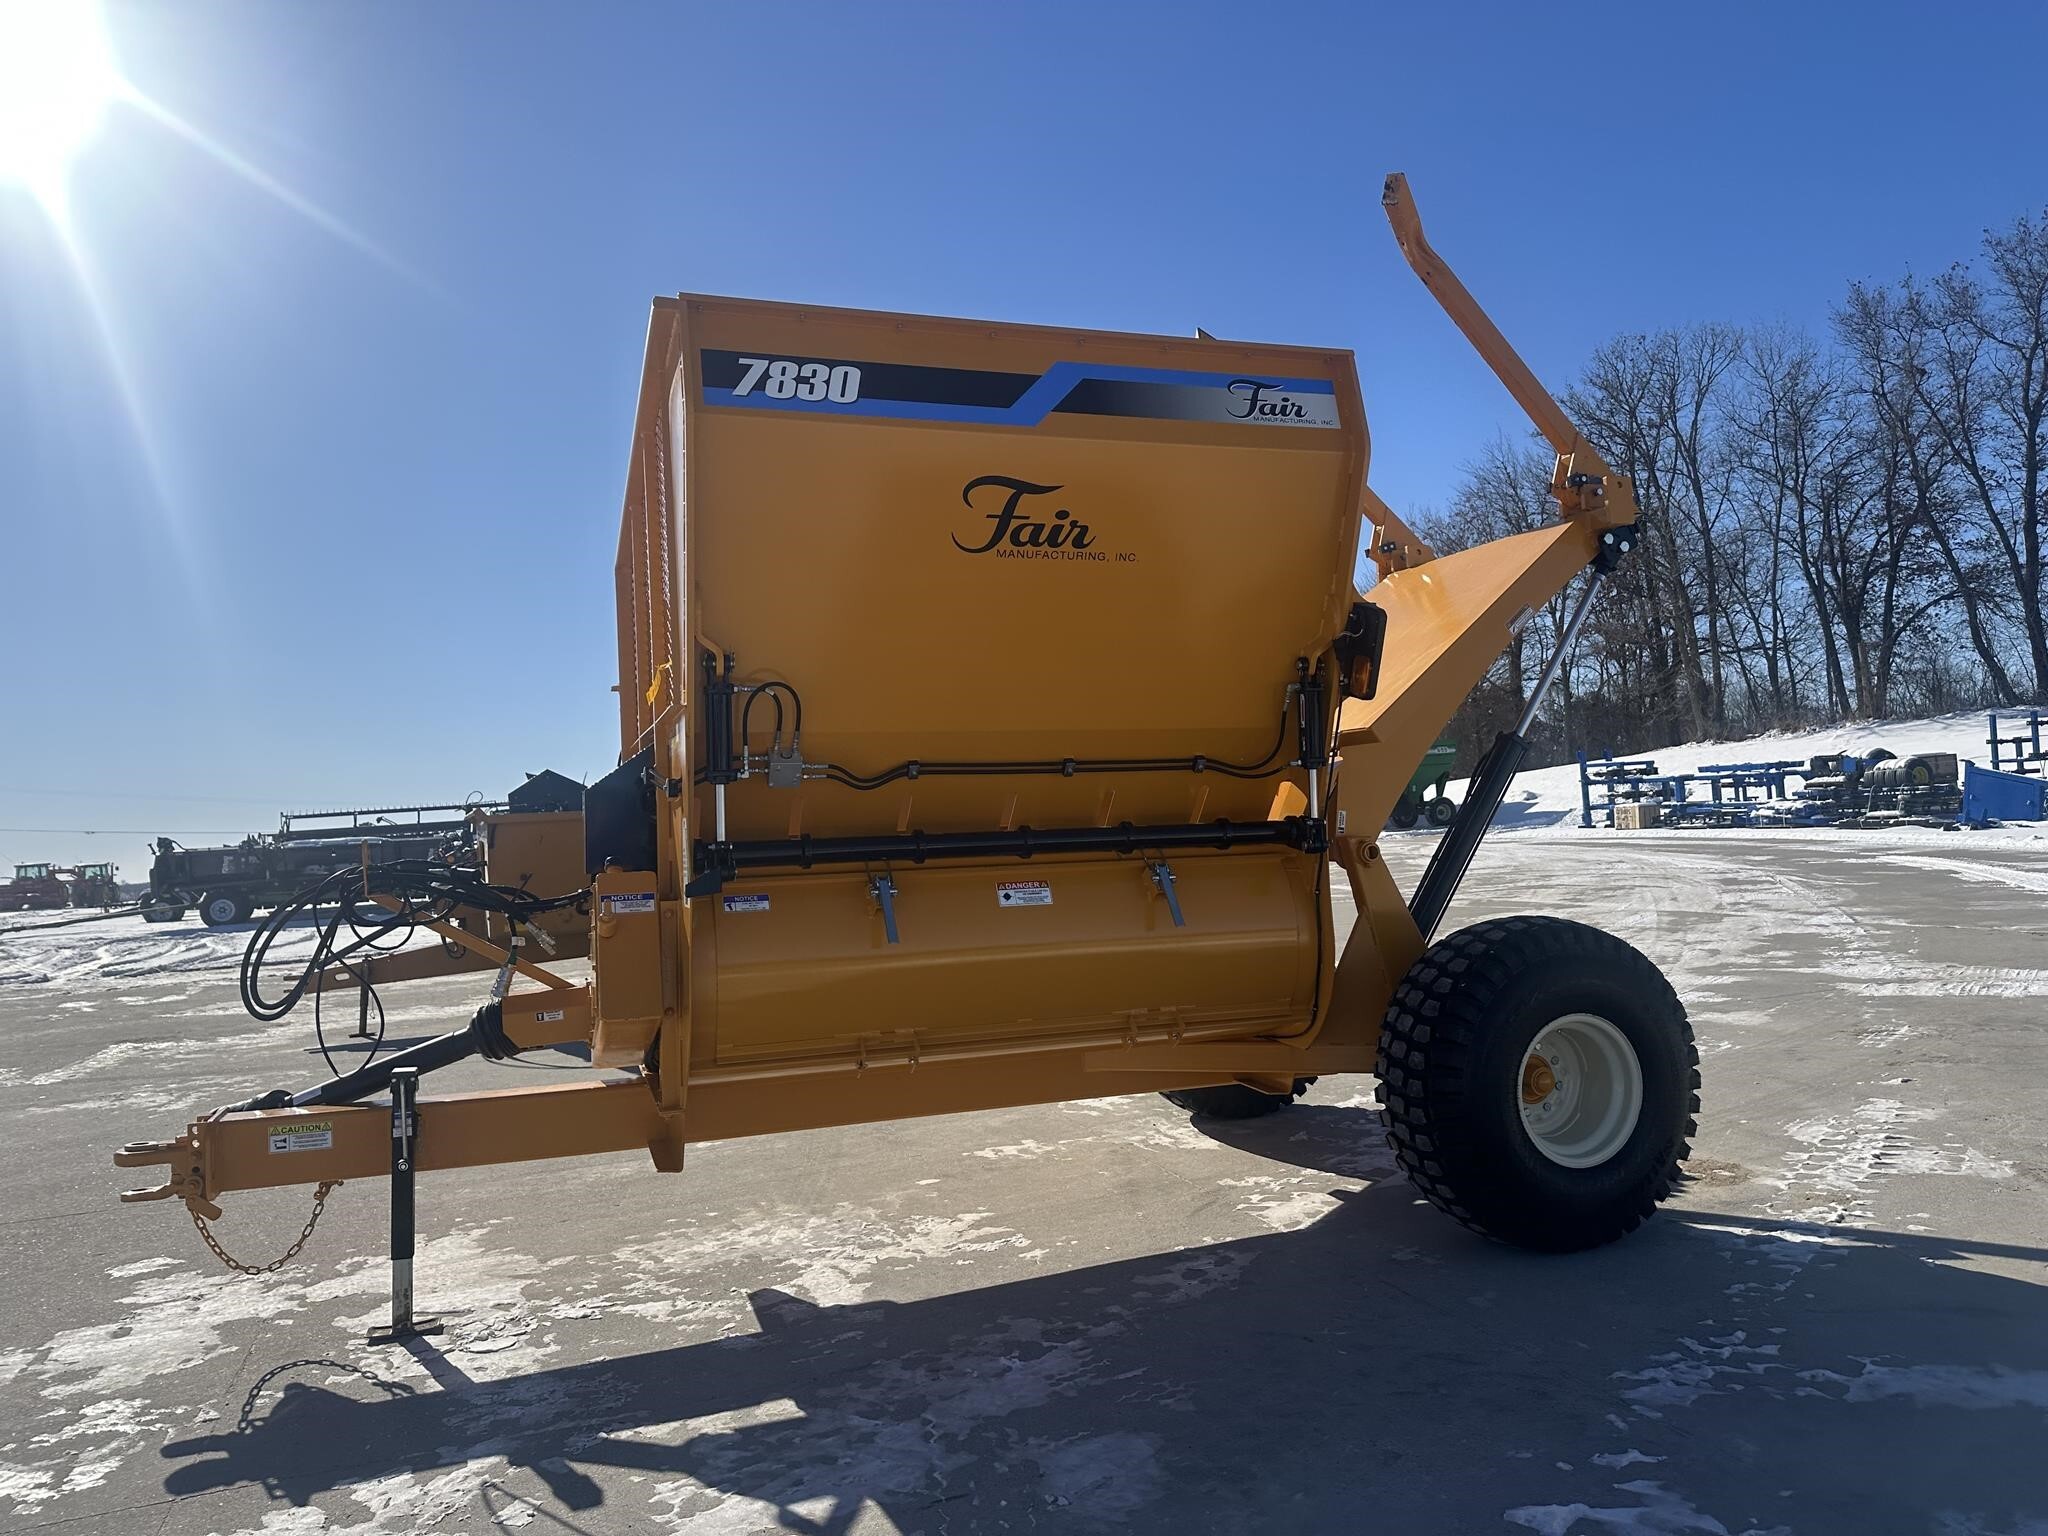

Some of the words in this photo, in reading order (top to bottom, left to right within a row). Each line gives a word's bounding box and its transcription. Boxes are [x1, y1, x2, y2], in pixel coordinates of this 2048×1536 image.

[732, 358, 861, 403] 7830
[1225, 379, 1308, 419] Fair
[1253, 416, 1317, 425] MANUFACTURING,
[951, 475, 1096, 553] Fair
[996, 549, 1110, 563] MANUFACTURING,
[1005, 881, 1041, 890] DANGER
[280, 1124, 321, 1134] CAUTION
